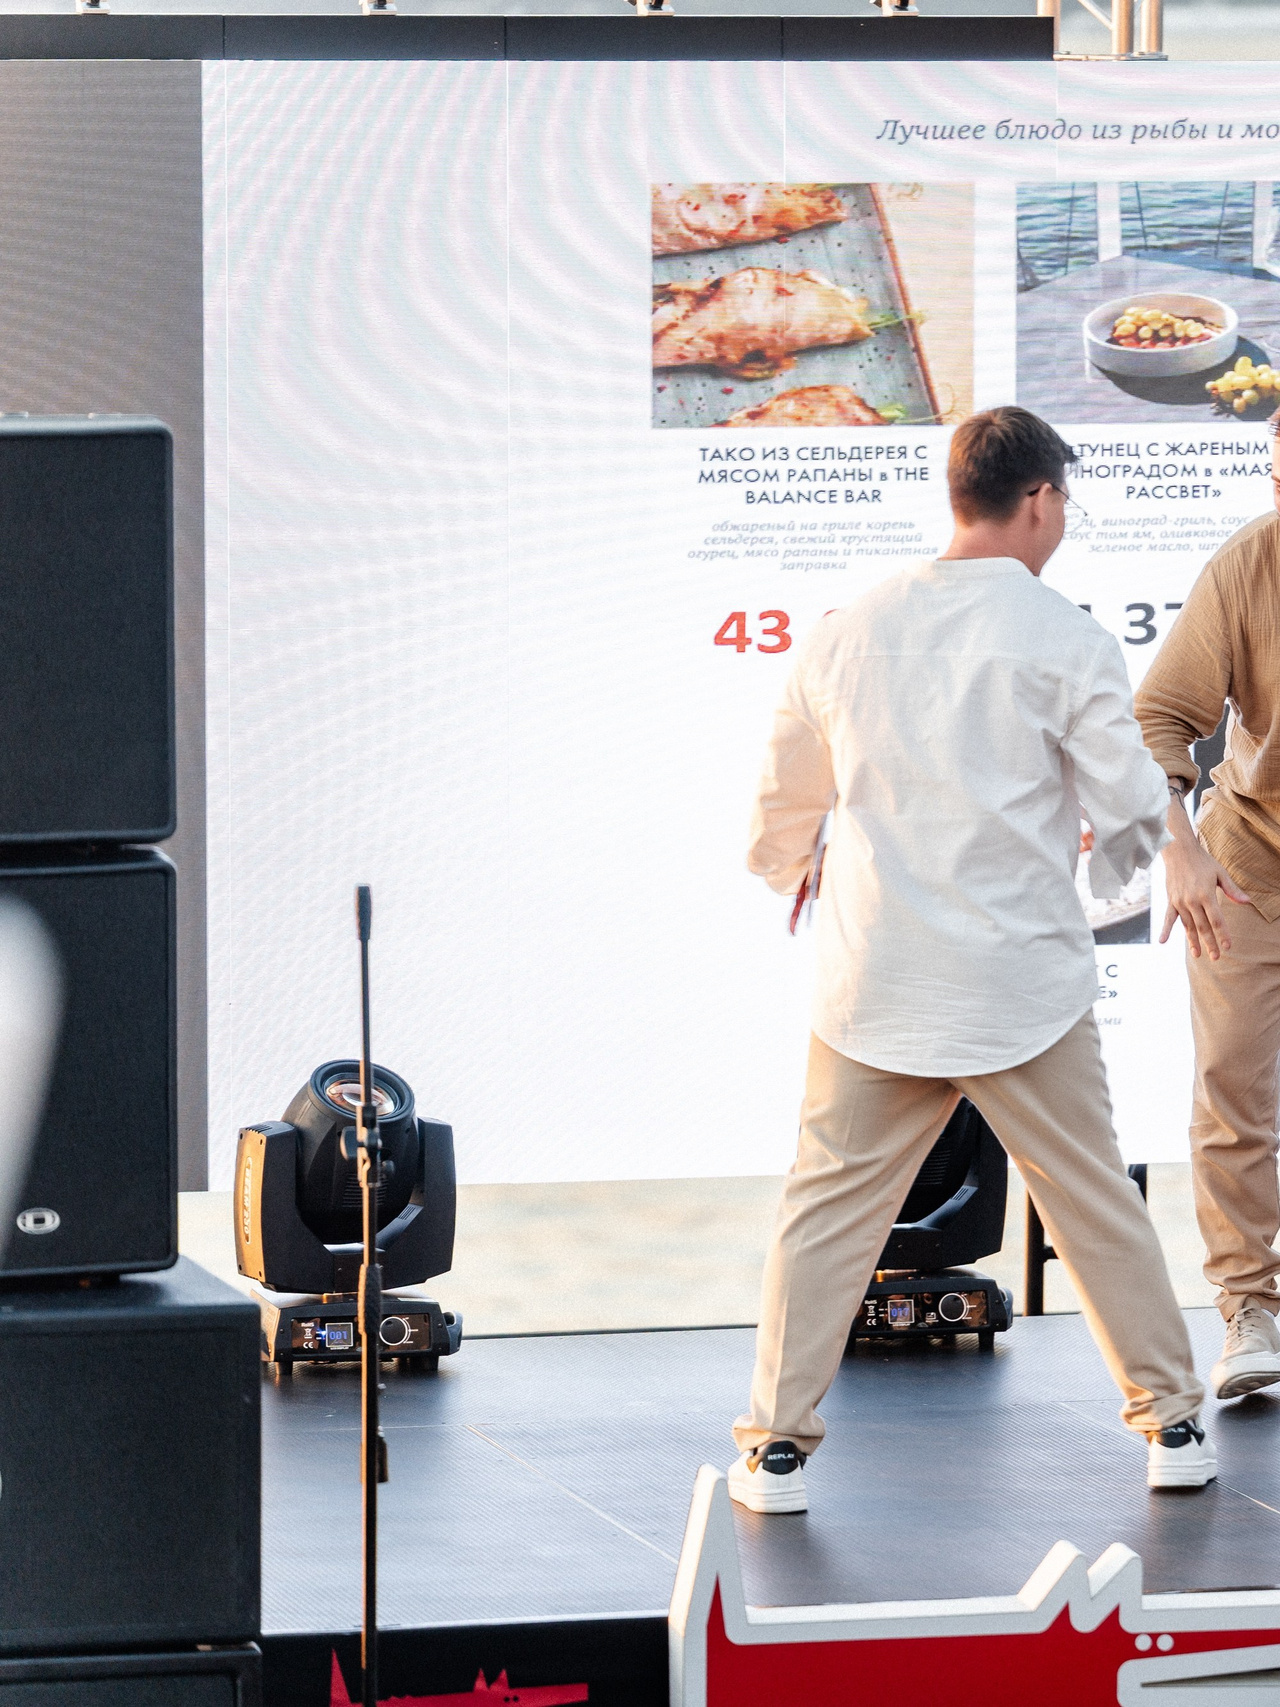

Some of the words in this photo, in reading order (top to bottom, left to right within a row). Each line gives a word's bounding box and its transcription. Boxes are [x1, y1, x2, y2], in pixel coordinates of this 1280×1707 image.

[875, 118, 986, 145] Лучшее
[995, 117, 1083, 141] блюдо
[1091, 123, 1122, 140] из
[1131, 118, 1207, 145] рыбы
[1217, 123, 1233, 140] и
[699, 447, 756, 462] ТАКО
[762, 447, 790, 461] ИЗ
[796, 445, 908, 463] СЕЛЬДЕРЕЯ
[914, 445, 928, 460] С
[1146, 442, 1160, 457] С
[1165, 441, 1270, 456] ЖАРЕНЫМ
[698, 468, 780, 484] МЯСОМ
[787, 467, 873, 483] РАПАНЫ
[879, 472, 889, 482] в
[895, 467, 930, 481] THE
[1204, 468, 1212, 477] в
[745, 489, 838, 505] BALANCE
[845, 489, 883, 504] BAR
[1126, 485, 1223, 500] РАССВЕТ»
[800, 522, 817, 532] на
[822, 521, 862, 533] гриле
[866, 520, 915, 533] корень
[703, 533, 779, 547] сельдерея,
[782, 532, 836, 545] свежий
[840, 532, 924, 546] хрустящий
[1096, 531, 1128, 540] том
[687, 549, 739, 563] огурец,
[743, 548, 779, 559] мясо
[783, 548, 839, 560] рапаны
[843, 547, 852, 557] и
[856, 546, 939, 558] пикантная
[1089, 544, 1143, 553] зеленое
[780, 560, 847, 573] заправка
